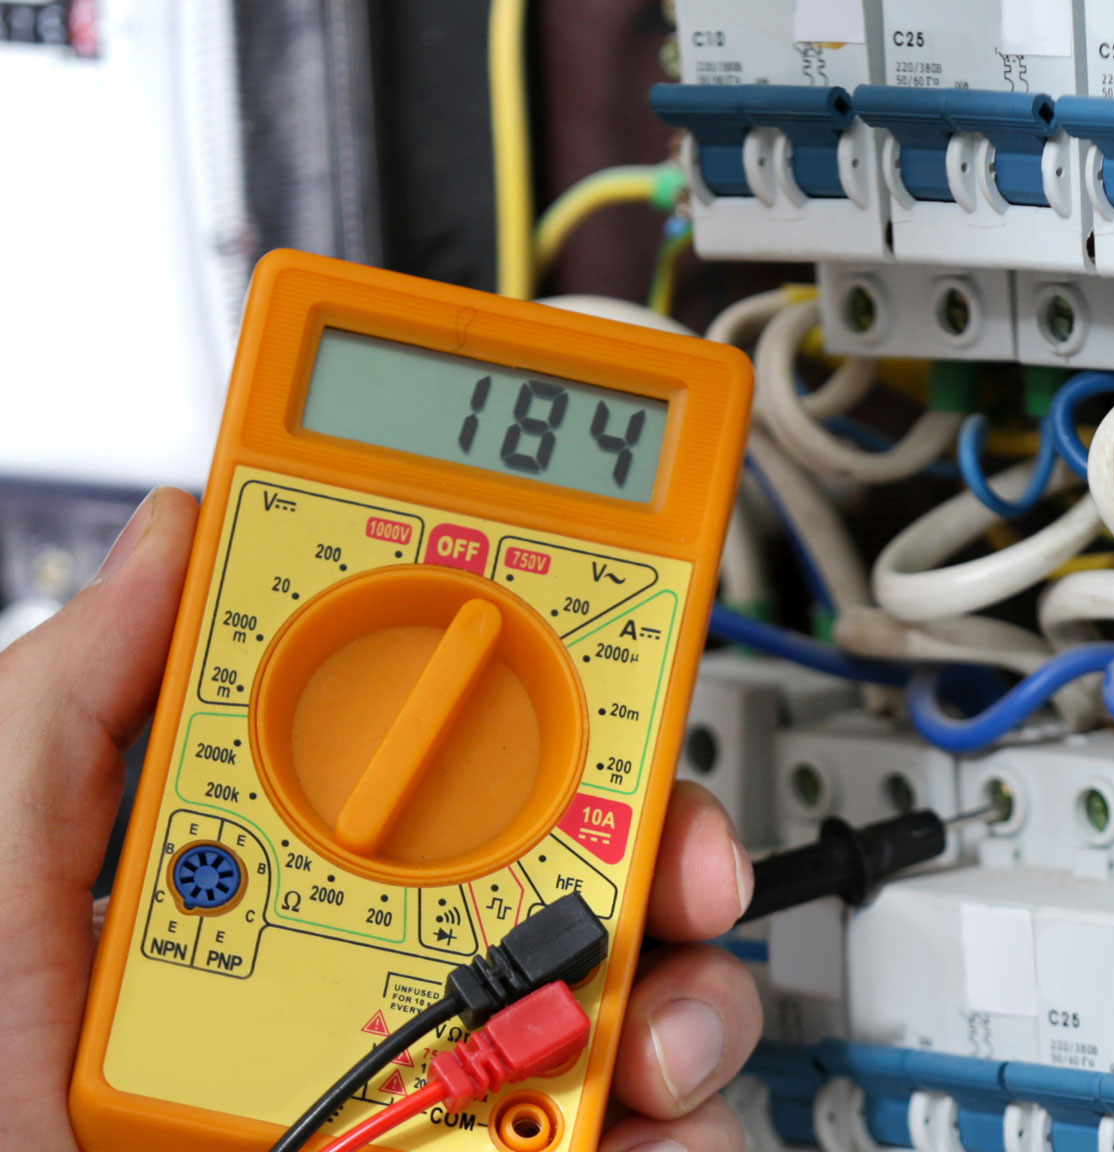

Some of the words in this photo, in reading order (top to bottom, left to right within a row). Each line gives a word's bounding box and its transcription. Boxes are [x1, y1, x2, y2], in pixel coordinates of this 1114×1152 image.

[893, 31, 925, 47] C25
[458, 375, 646, 489] 184
[368, 519, 411, 543] 1000V
[314, 543, 342, 562] 200
[436, 534, 481, 562] OFF
[511, 550, 548, 572] 750V
[271, 576, 291, 594] 20
[562, 596, 590, 616] 200
[223, 610, 257, 631] 2000
[232, 630, 247, 644] m
[211, 666, 237, 685] 200
[216, 685, 230, 698] m
[609, 702, 640, 721] 20m
[195, 742, 237, 766] 2000k
[606, 757, 632, 775] 200
[609, 772, 624, 785] m
[205, 781, 240, 803] 200k
[582, 806, 616, 829] 10A
[188, 823, 199, 836] E
[165, 842, 175, 855] B
[236, 833, 247, 847] E
[256, 862, 267, 875] B
[285, 852, 313, 873] 20k
[555, 873, 584, 894] hFE
[154, 889, 165, 903] C
[281, 890, 302, 913] Ω
[309, 884, 345, 906] 2000
[245, 909, 256, 923] C
[365, 908, 393, 927] 200
[167, 920, 178, 934] E
[215, 930, 226, 944] E
[150, 937, 188, 961] NPN
[205, 949, 243, 972] PNP
[392, 993, 412, 1004] FOR
[393, 983, 440, 1000] UNFUSED
[1048, 1009, 1081, 1029] C25
